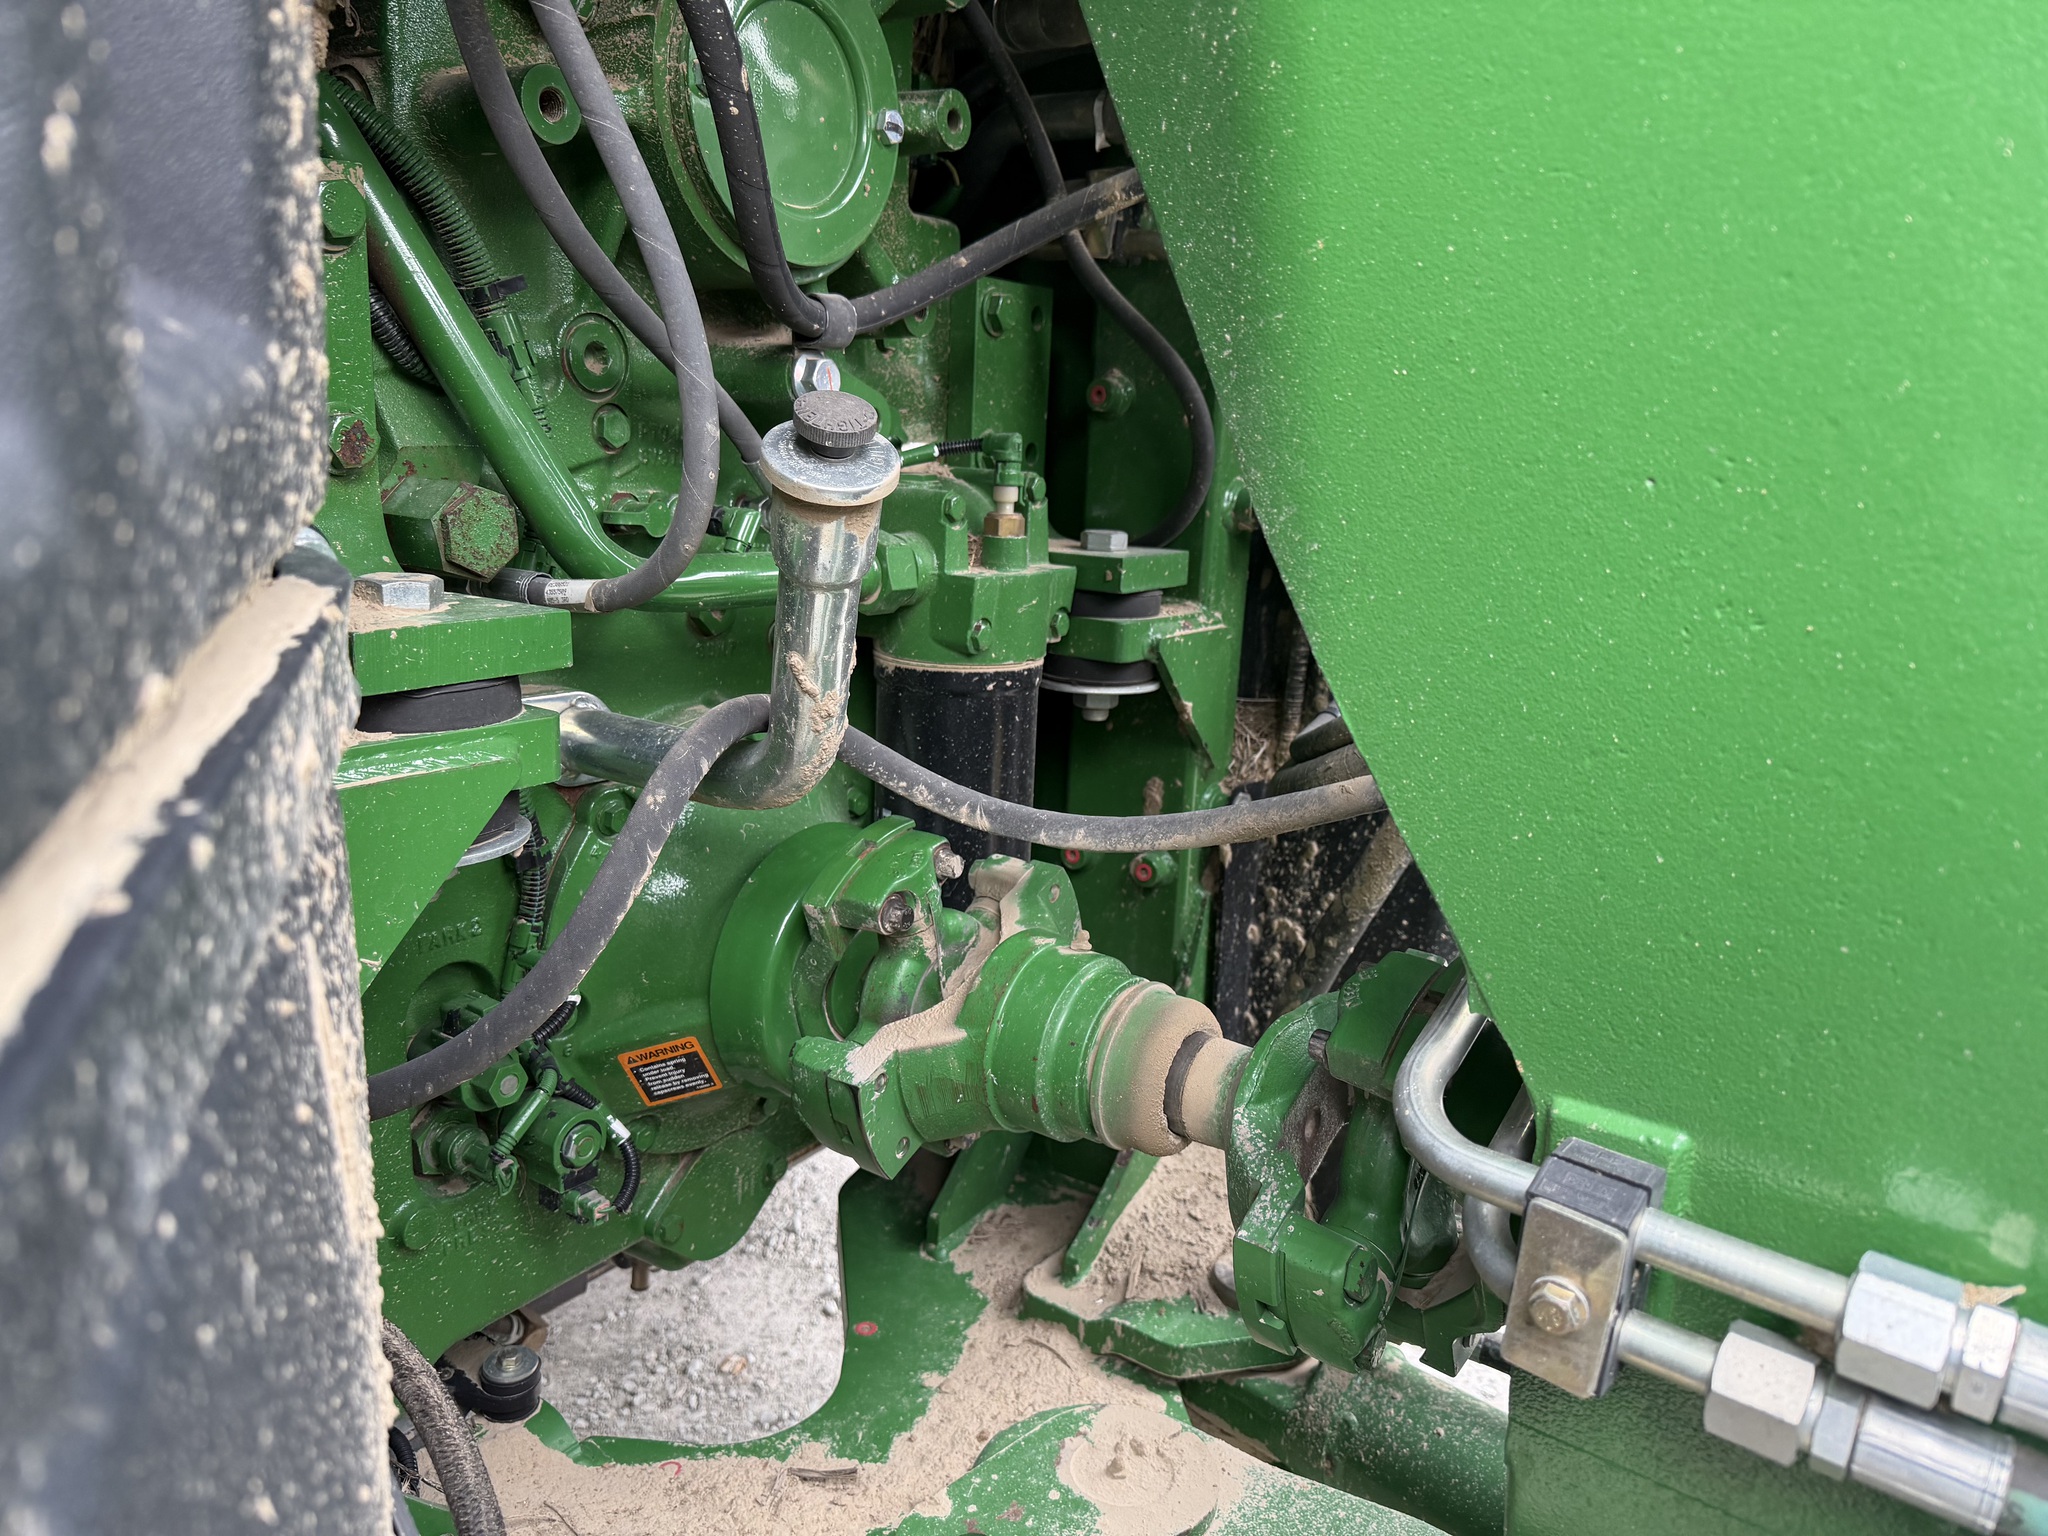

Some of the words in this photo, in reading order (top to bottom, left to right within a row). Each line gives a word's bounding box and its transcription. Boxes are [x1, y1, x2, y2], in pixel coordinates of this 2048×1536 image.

[636, 1041, 695, 1062] WARNING
[639, 1062, 666, 1073] Contains
[667, 1056, 687, 1065] spring
[642, 1069, 660, 1077] under
[645, 1072, 668, 1081] Prevent
[650, 1082, 672, 1091] release
[681, 1073, 709, 1083] removing
[662, 1074, 685, 1083] sudden
[653, 1085, 685, 1096] capscrews
[685, 1079, 707, 1088] evenly.
